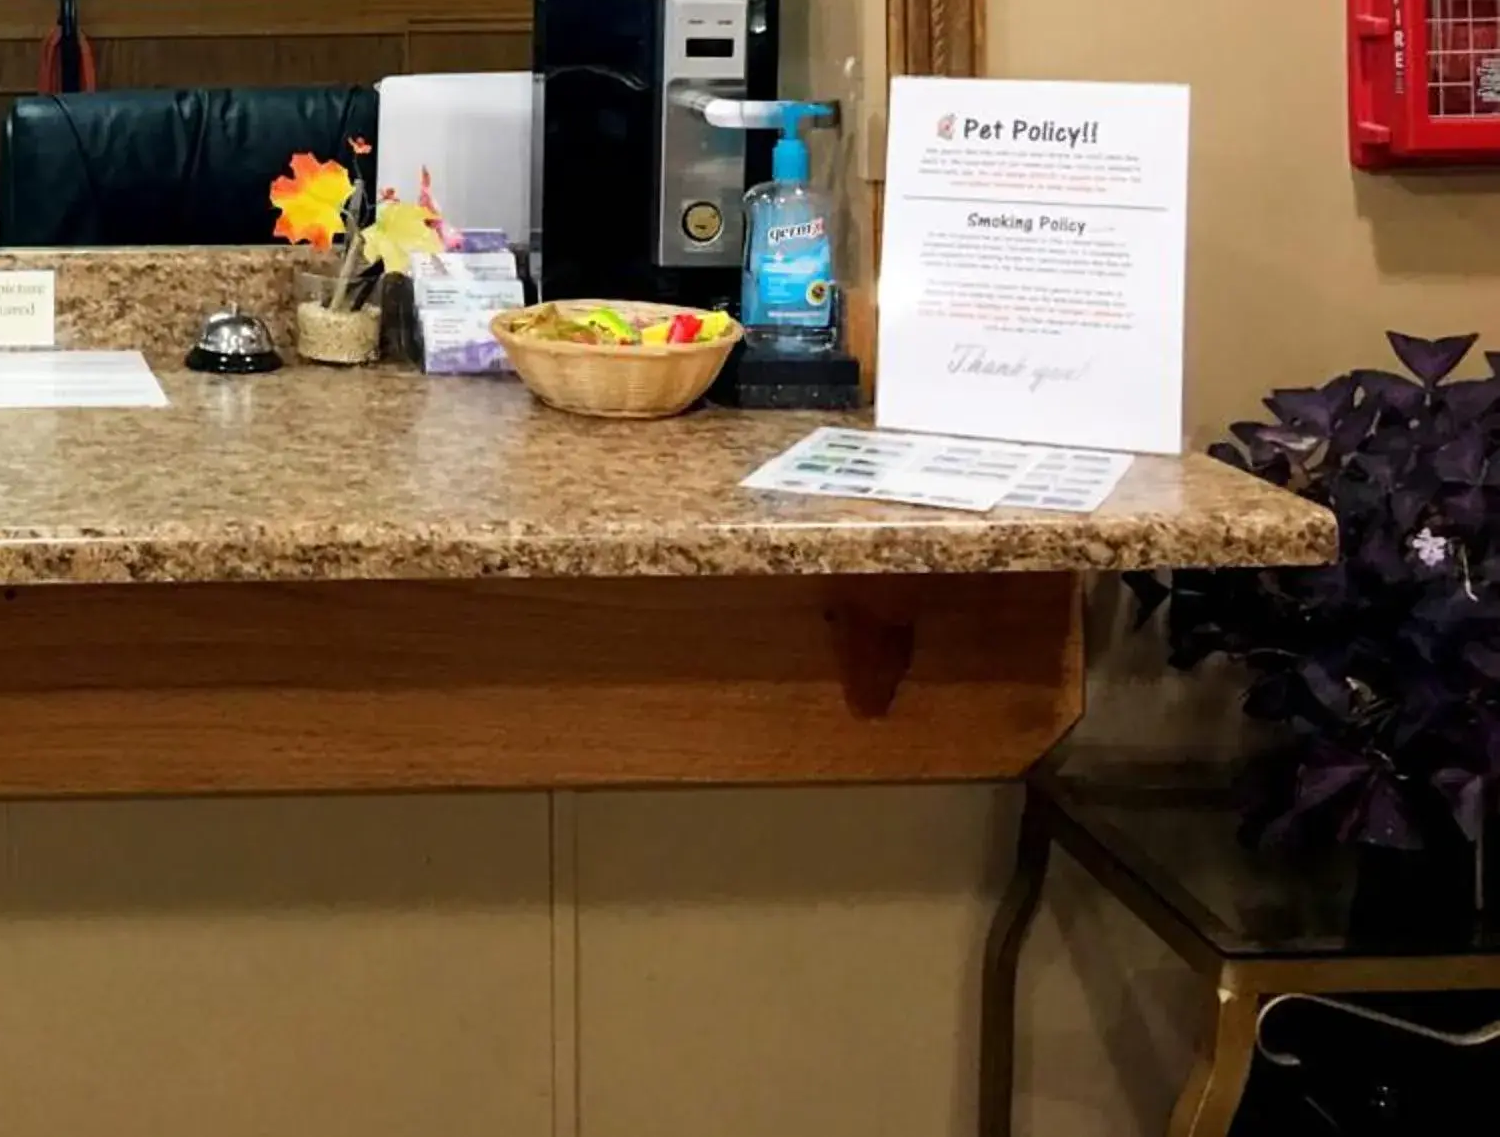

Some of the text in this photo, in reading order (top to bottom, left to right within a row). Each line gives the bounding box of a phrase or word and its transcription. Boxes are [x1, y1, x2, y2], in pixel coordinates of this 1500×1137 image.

[963, 118, 1099, 148] Pet Policy!!
[967, 213, 1086, 235] Smoking Policy
[947, 343, 1028, 377] Thank
